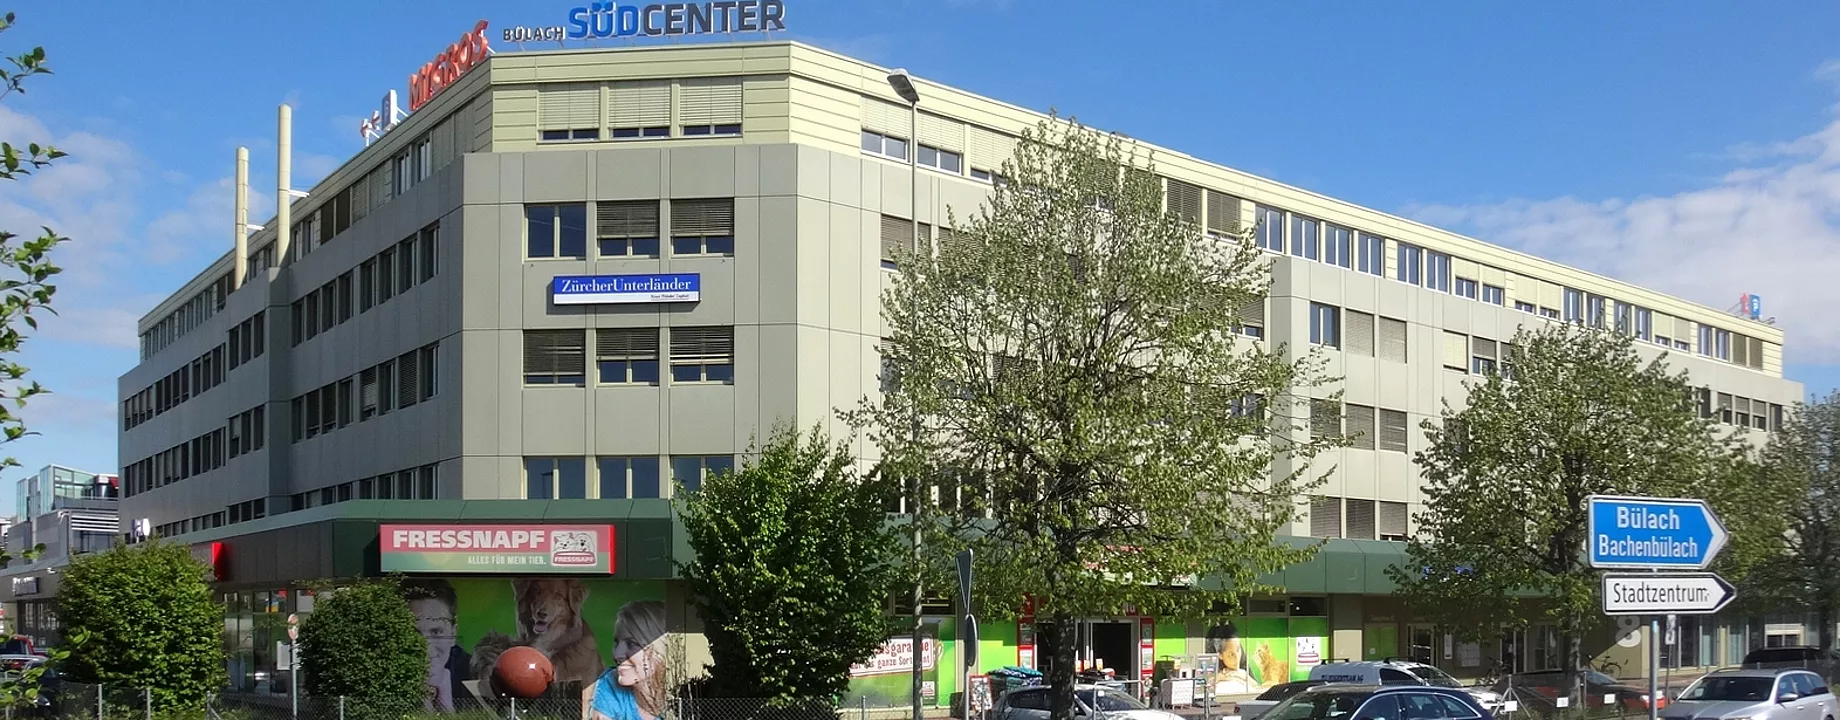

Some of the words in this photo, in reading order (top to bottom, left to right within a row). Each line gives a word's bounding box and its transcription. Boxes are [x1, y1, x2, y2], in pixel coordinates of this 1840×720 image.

[503, 26, 566, 42] BÜLACH
[568, 0, 787, 39] SÜDCENTER
[408, 19, 489, 111] MIGROS
[561, 277, 692, 293] ZürcherUnterländer
[1616, 506, 1680, 530] Bülach
[393, 530, 545, 549] FRESSNAPF
[1598, 534, 1698, 558] Bachenbülach
[468, 555, 490, 565] ALLES
[492, 554, 506, 565] FÜR
[507, 555, 526, 565] MEIN
[1613, 581, 1710, 603] Stadtzentrum
